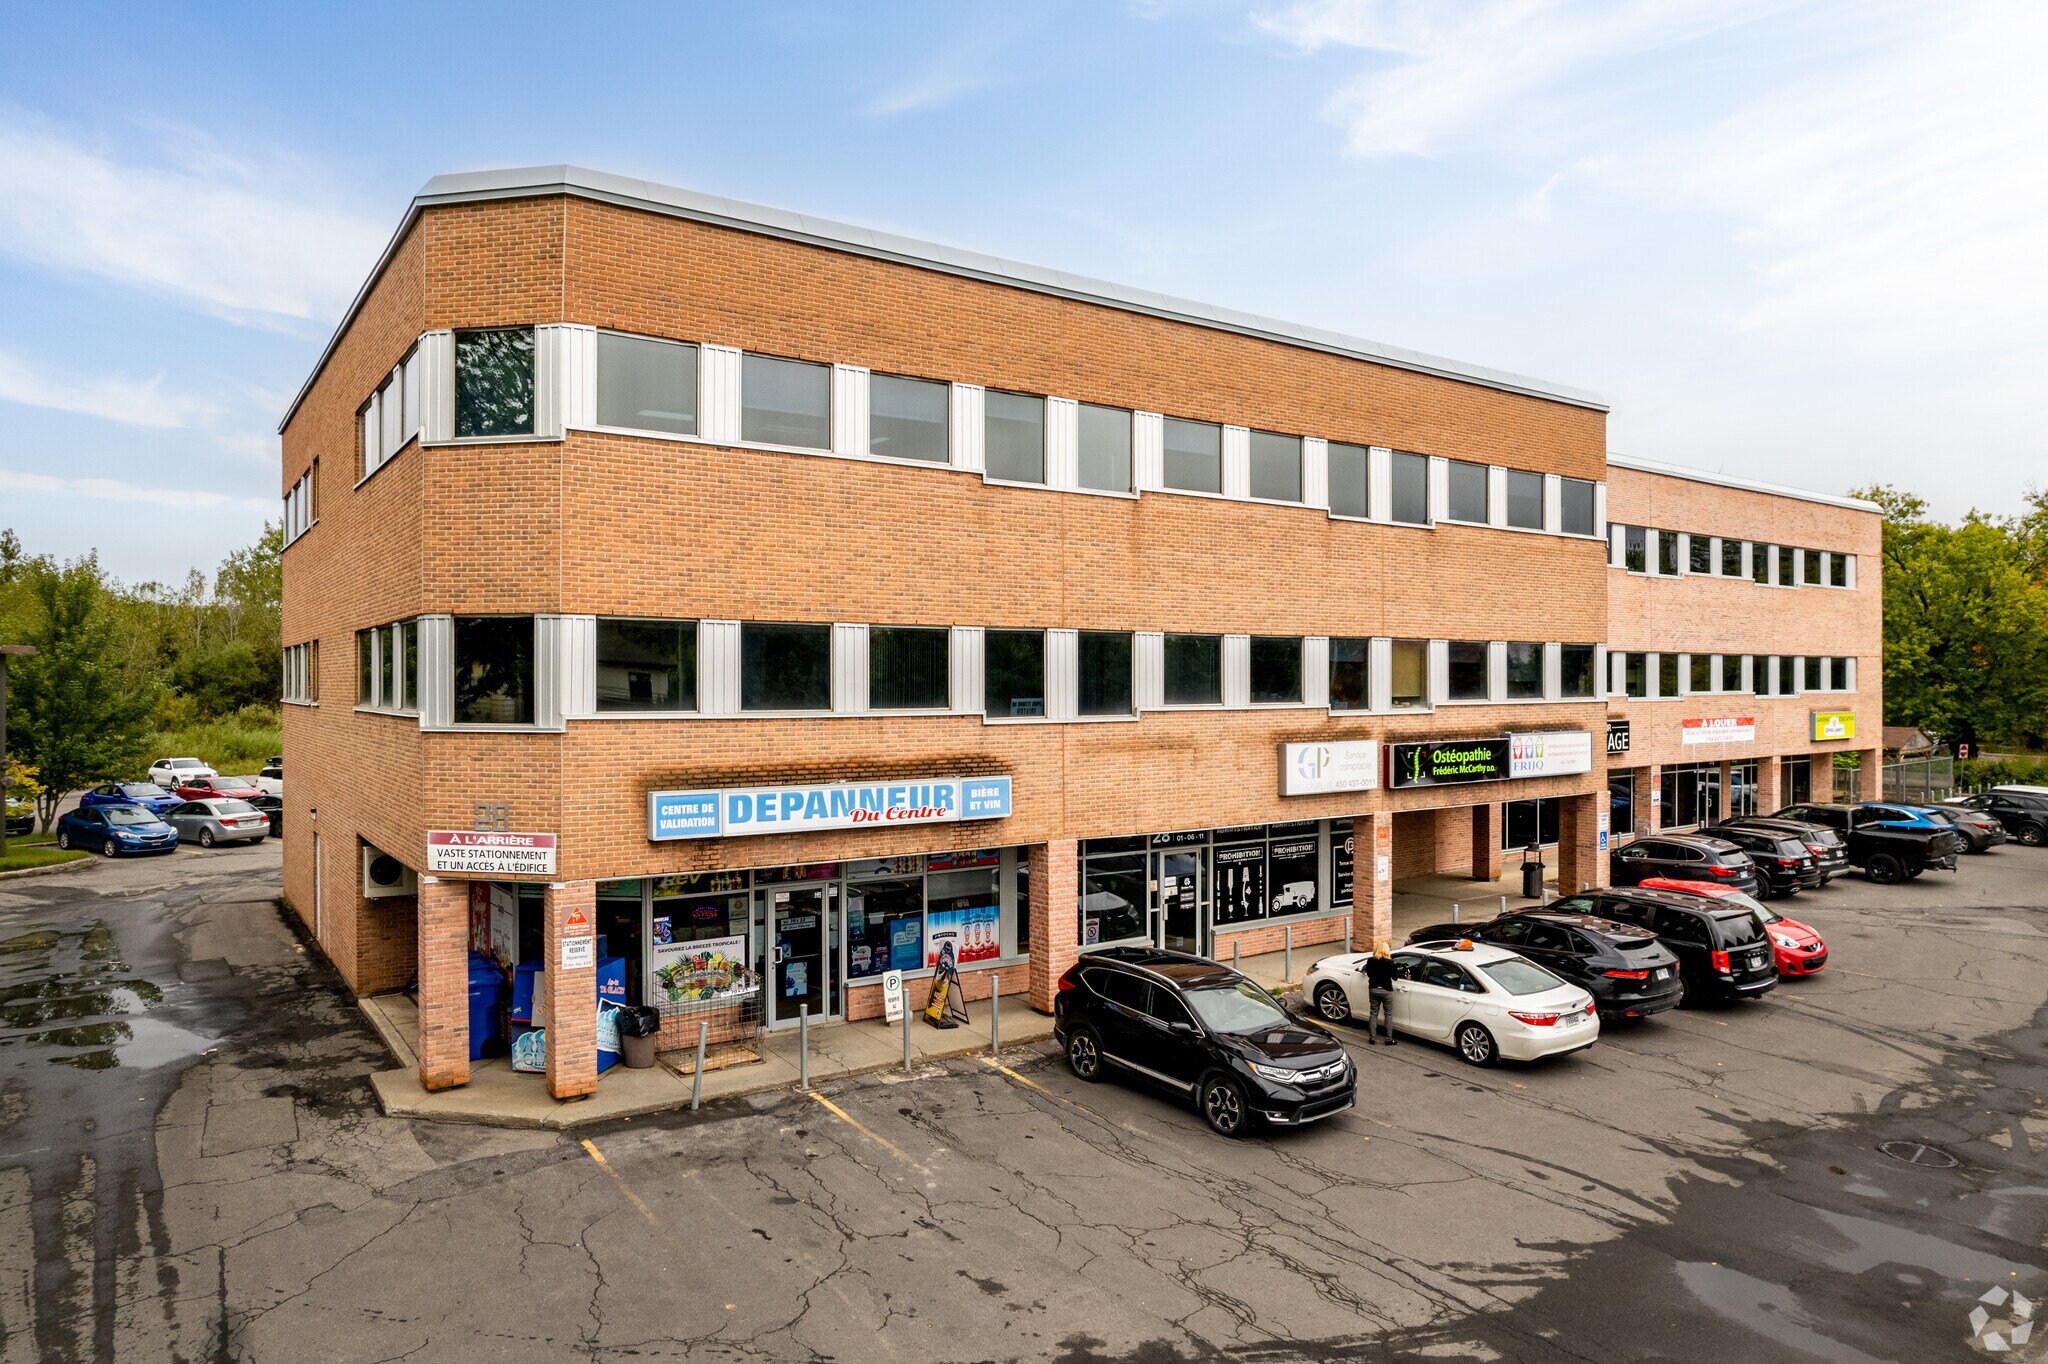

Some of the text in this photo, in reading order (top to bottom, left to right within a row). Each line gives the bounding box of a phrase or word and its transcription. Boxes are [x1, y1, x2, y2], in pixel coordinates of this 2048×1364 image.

[1709, 719, 1737, 727] LOUER
[1607, 732, 1629, 750] AGE
[1345, 751, 1367, 760] Service
[1433, 747, 1492, 765] Ostéopathie
[1340, 762, 1372, 772] comptable
[1433, 765, 1459, 776] Frédéric
[1460, 763, 1486, 774] McCarthy
[1513, 760, 1544, 771] FRIJQ
[1335, 780, 1347, 788] 450
[971, 786, 1000, 799] BIÈRE
[661, 803, 714, 816] CENTRE DE
[728, 784, 954, 824] DEPANNEUR
[970, 799, 1000, 811] ET VIN
[474, 802, 509, 832] 28
[850, 805, 947, 823] Du Centre
[660, 816, 715, 830] VALIDATION
[450, 833, 534, 846] À L'ARRIÈRE
[437, 848, 548, 860] VASTE STATIONNEMENT
[437, 860, 548, 873] ET UN ACCÈS À L'ÉDIFICE
[562, 938, 592, 948] STATIONNEMENT
[657, 946, 685, 954] SAVOUREZ
[889, 978, 897, 988] P
[522, 1035, 546, 1053] AR
